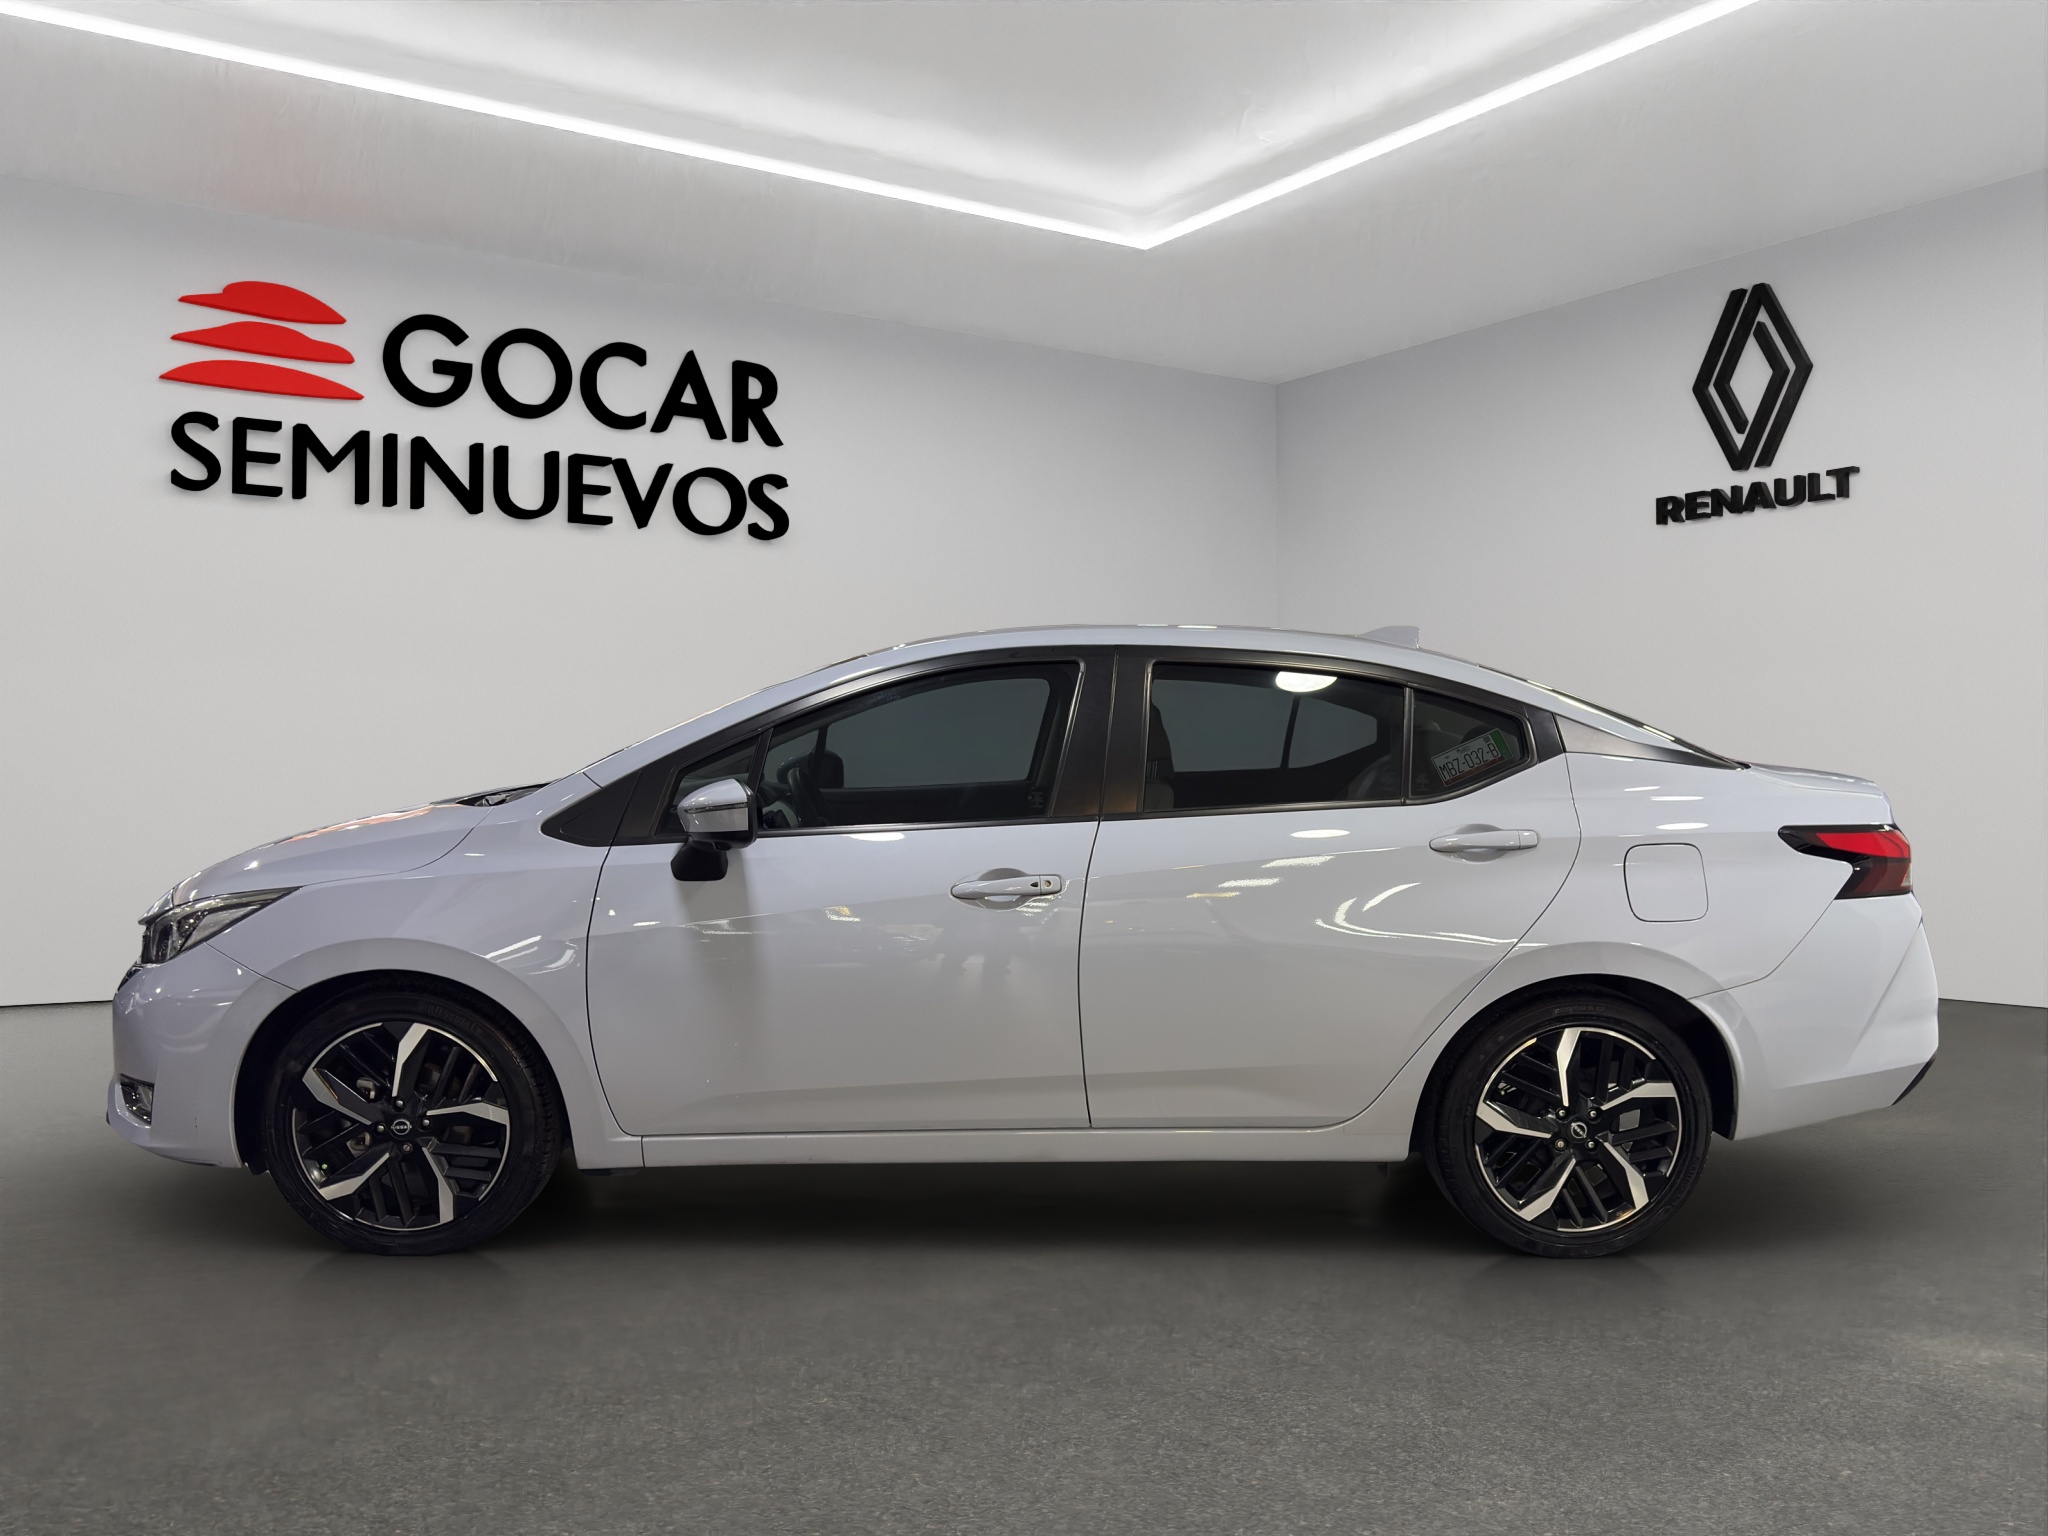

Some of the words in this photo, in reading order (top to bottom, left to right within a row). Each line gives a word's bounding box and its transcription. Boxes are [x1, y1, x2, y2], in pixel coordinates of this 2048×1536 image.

[382, 313, 784, 448] GOCAR
[170, 411, 790, 541] SEMINUEVOS
[1655, 466, 1860, 525] RENAULT
[1438, 742, 1500, 780] MBZ-032-B
